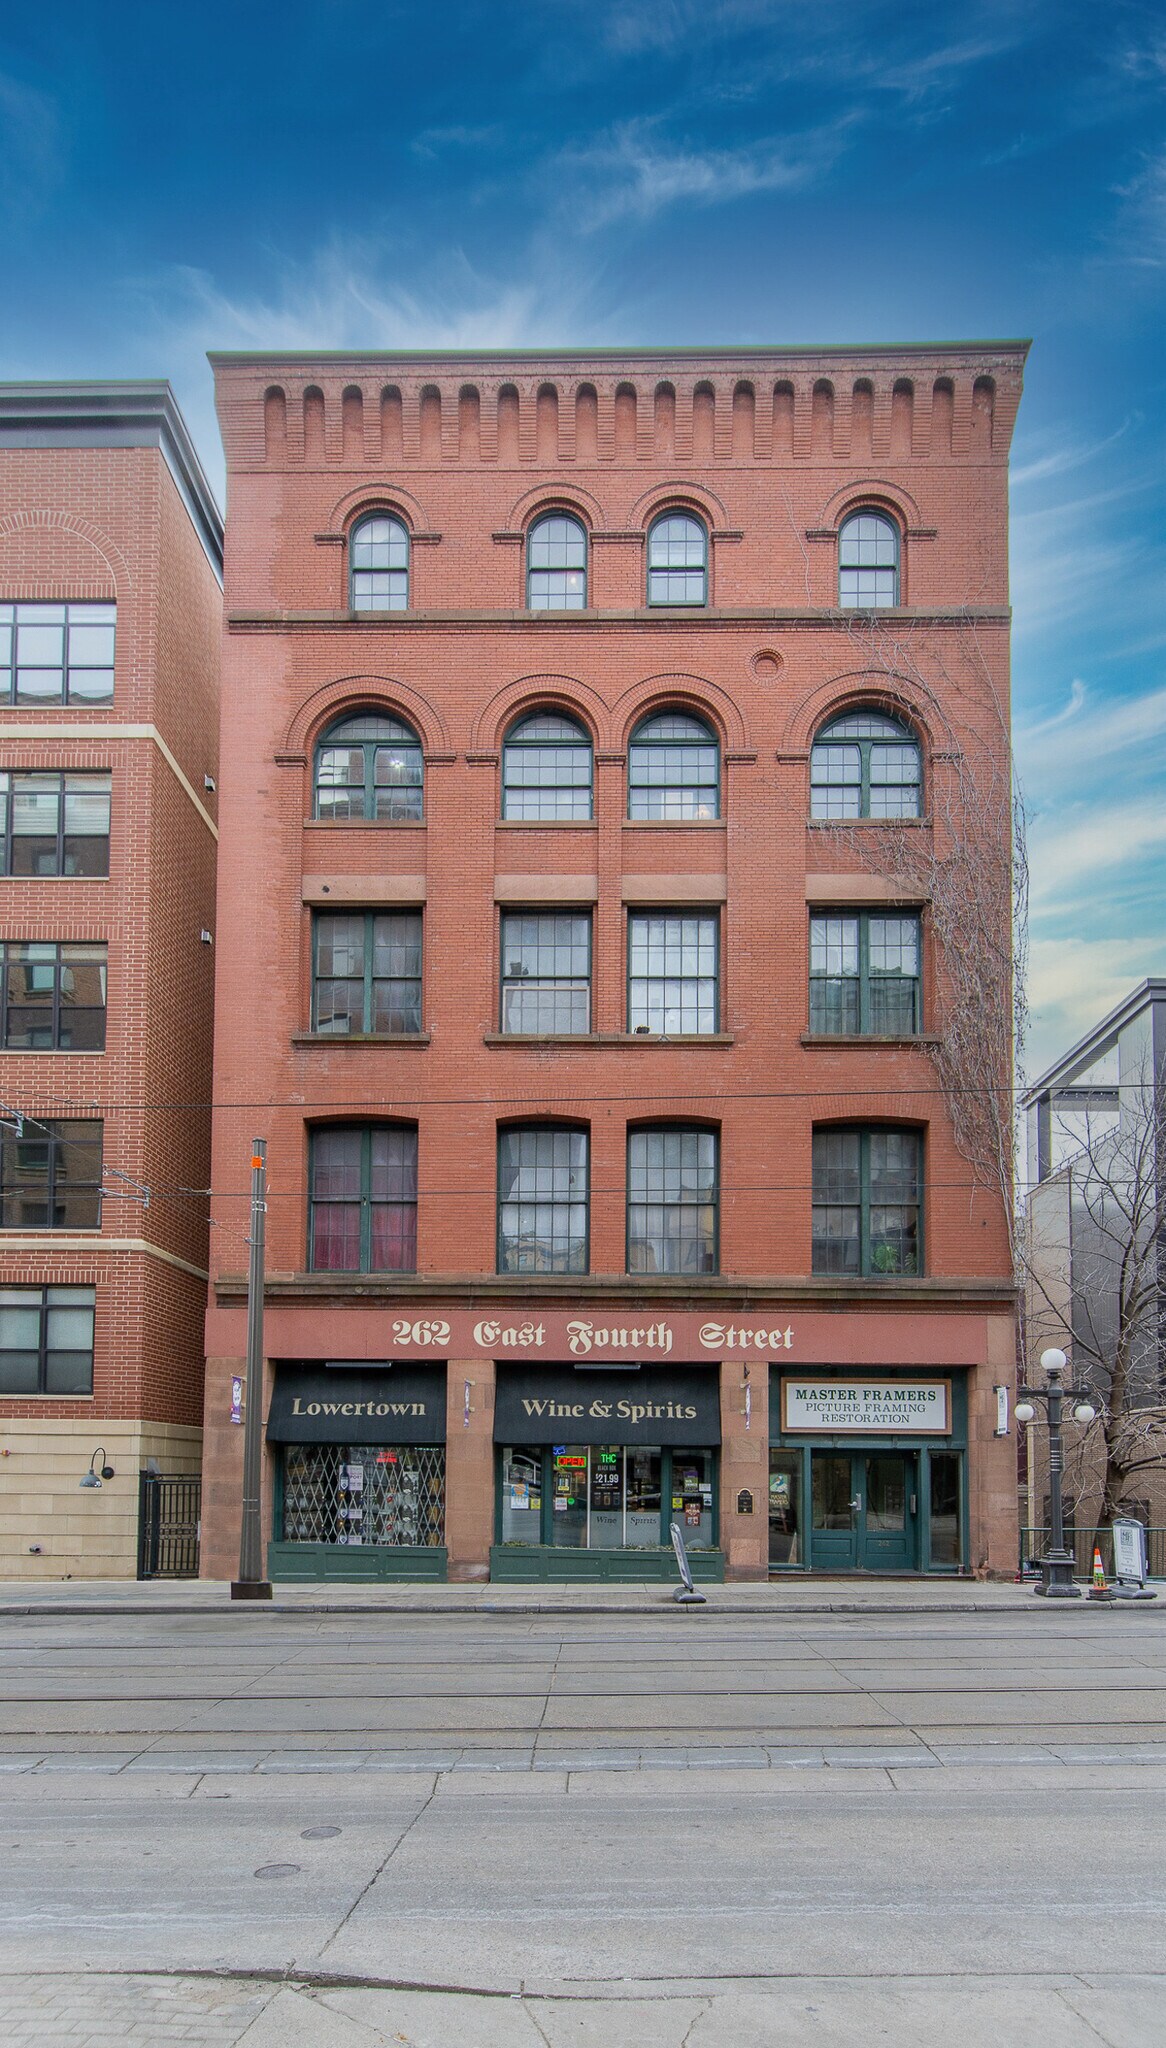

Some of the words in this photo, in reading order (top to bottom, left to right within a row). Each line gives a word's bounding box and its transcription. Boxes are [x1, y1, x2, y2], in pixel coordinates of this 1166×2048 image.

[392, 1320, 450, 1346] 262
[473, 1320, 546, 1348] East
[566, 1320, 673, 1355] Fourth
[699, 1322, 795, 1349] Street
[795, 1389, 857, 1401] MASTER
[863, 1390, 936, 1402] FRAMERS
[291, 1397, 426, 1416] Lowertown
[521, 1399, 584, 1417] Wine
[588, 1399, 613, 1418] &
[616, 1399, 697, 1424] Spirits
[805, 1402, 861, 1412] PICTURE
[865, 1403, 926, 1413] FRAMING
[821, 1413, 910, 1423] RESTORATION
[558, 1457, 585, 1467] OPEN
[601, 1454, 617, 1463] THC
[595, 1473, 619, 1483] $21.99
[597, 1516, 617, 1524] Wine
[630, 1516, 657, 1526] Spirits
